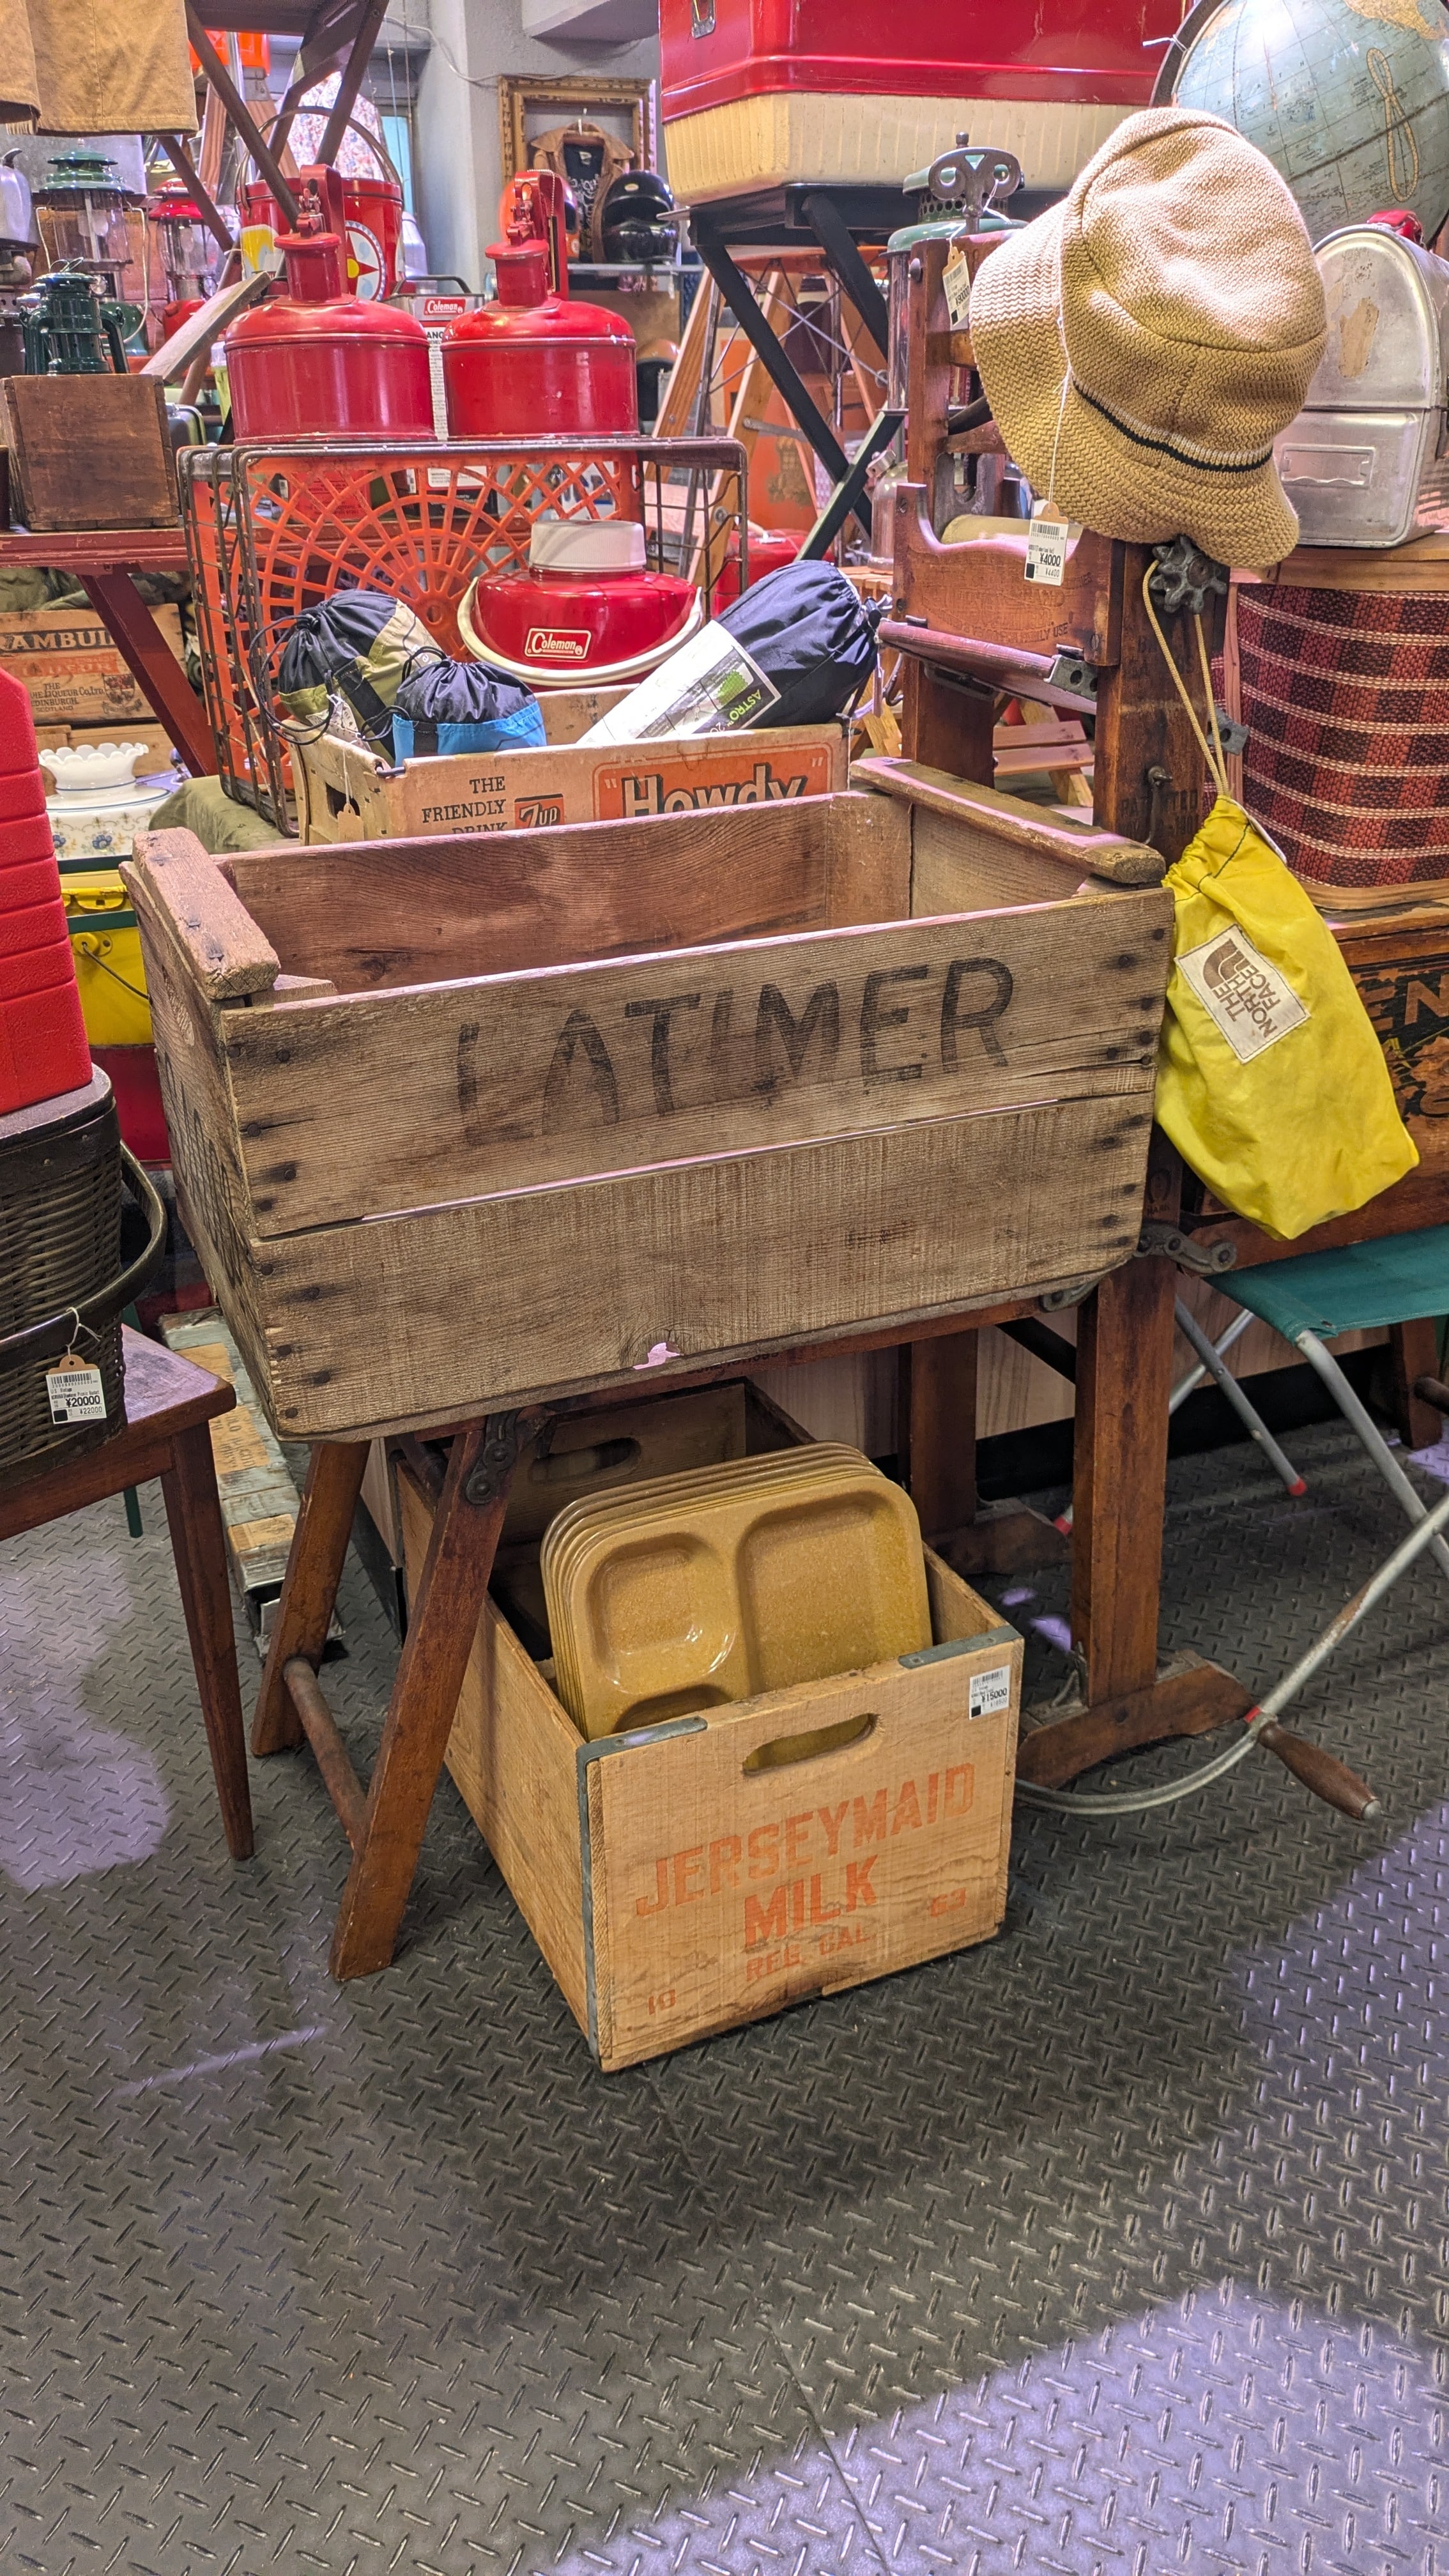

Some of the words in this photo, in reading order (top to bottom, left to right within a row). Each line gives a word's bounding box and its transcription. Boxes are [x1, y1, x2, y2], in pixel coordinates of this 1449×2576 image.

[427, 300, 458, 314] Coleman
[1040, 553, 1061, 567] ¥4000
[1045, 567, 1060, 578] ¥4400
[531, 632, 576, 654] Coleman
[44, 682, 61, 691] THE
[469, 776, 506, 794] THE
[422, 799, 507, 824] FRIENDLY
[1240, 964, 1281, 1011] FACE
[1212, 983, 1245, 1022] THE
[1227, 971, 1278, 1038] NORTH
[457, 957, 1015, 1147] LATIMER
[66, 1395, 100, 1407] ¥20000
[79, 1406, 102, 1414] ¥22000
[981, 1687, 1008, 1703] ¥15000
[636, 1762, 976, 1917] JERSEYMAID
[744, 1854, 878, 1949] MILK
